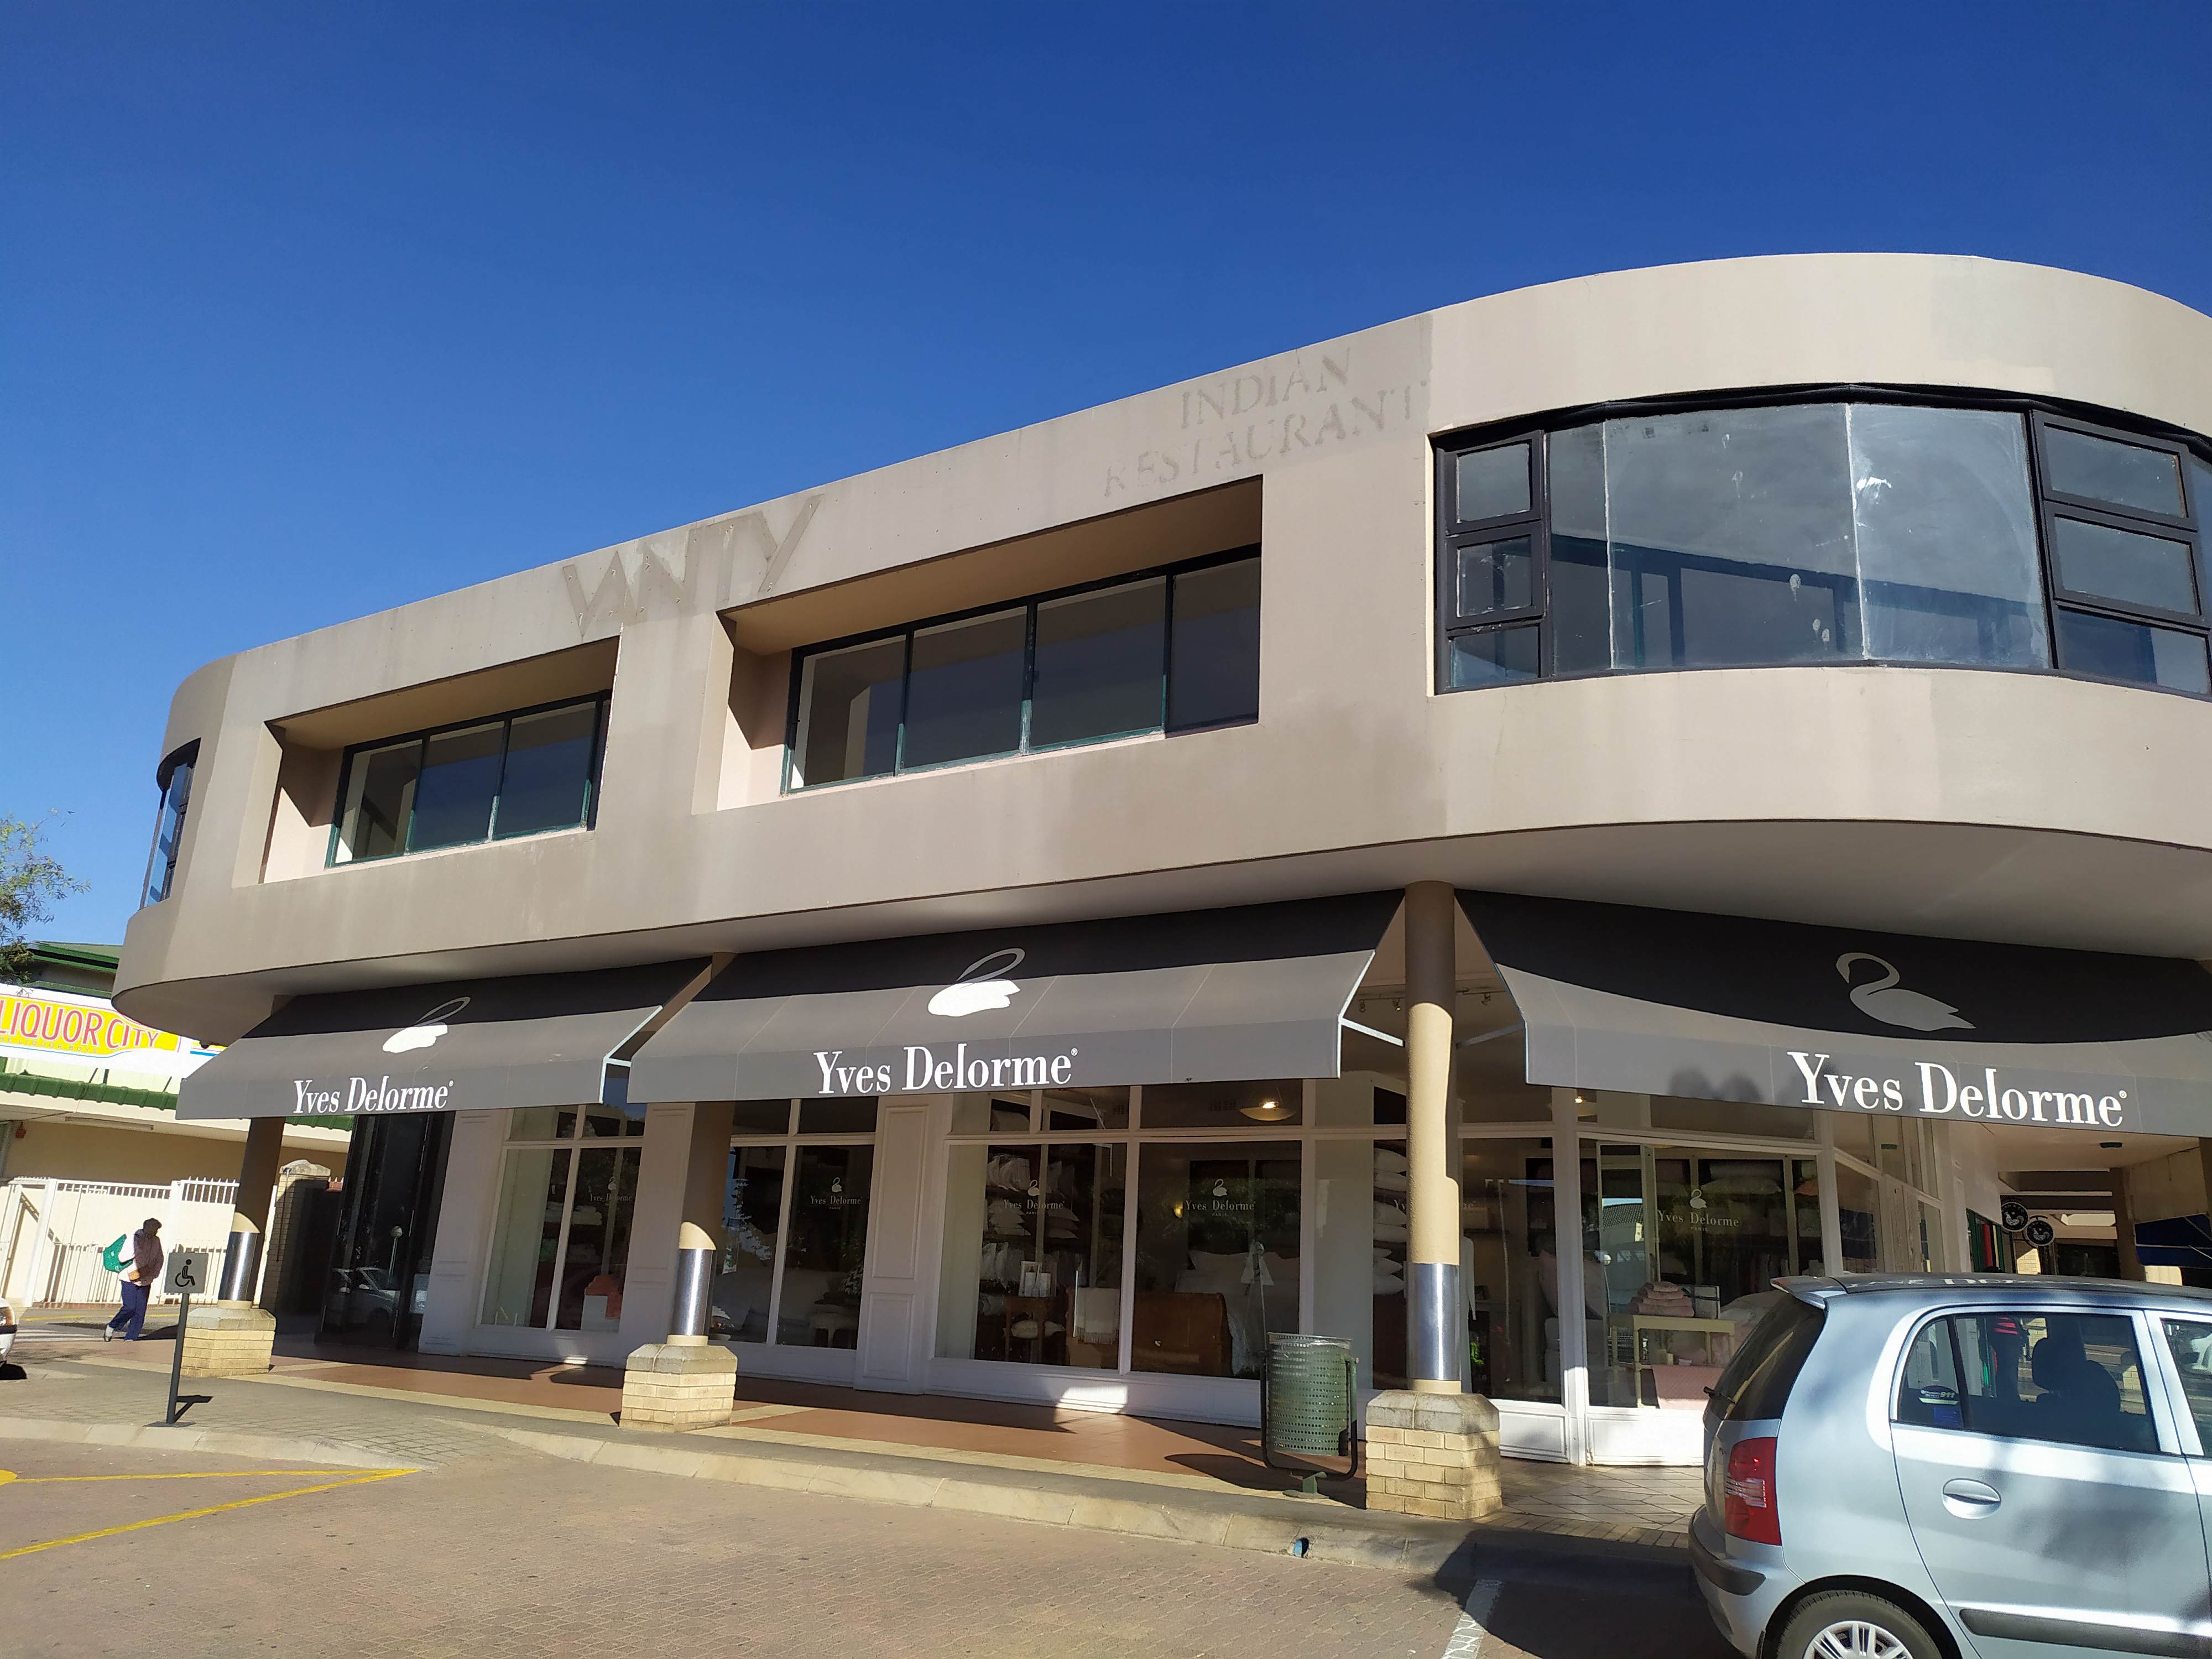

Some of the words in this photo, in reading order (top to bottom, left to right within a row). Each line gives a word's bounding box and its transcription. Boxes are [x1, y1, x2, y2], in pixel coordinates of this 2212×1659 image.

[1181, 348, 1351, 429] INDIAN
[0, 1000, 102, 1046] LIQUOR
[106, 1018, 159, 1048] CITY
[813, 1051, 891, 1094] Yves
[1787, 1051, 1903, 1112] Yves
[293, 1079, 341, 1114] Yves
[810, 1195, 826, 1204] Yves
[1004, 1199, 1022, 1209] Yves
[1186, 1199, 1207, 1211] Yves
[1657, 1209, 1683, 1223] Yves
